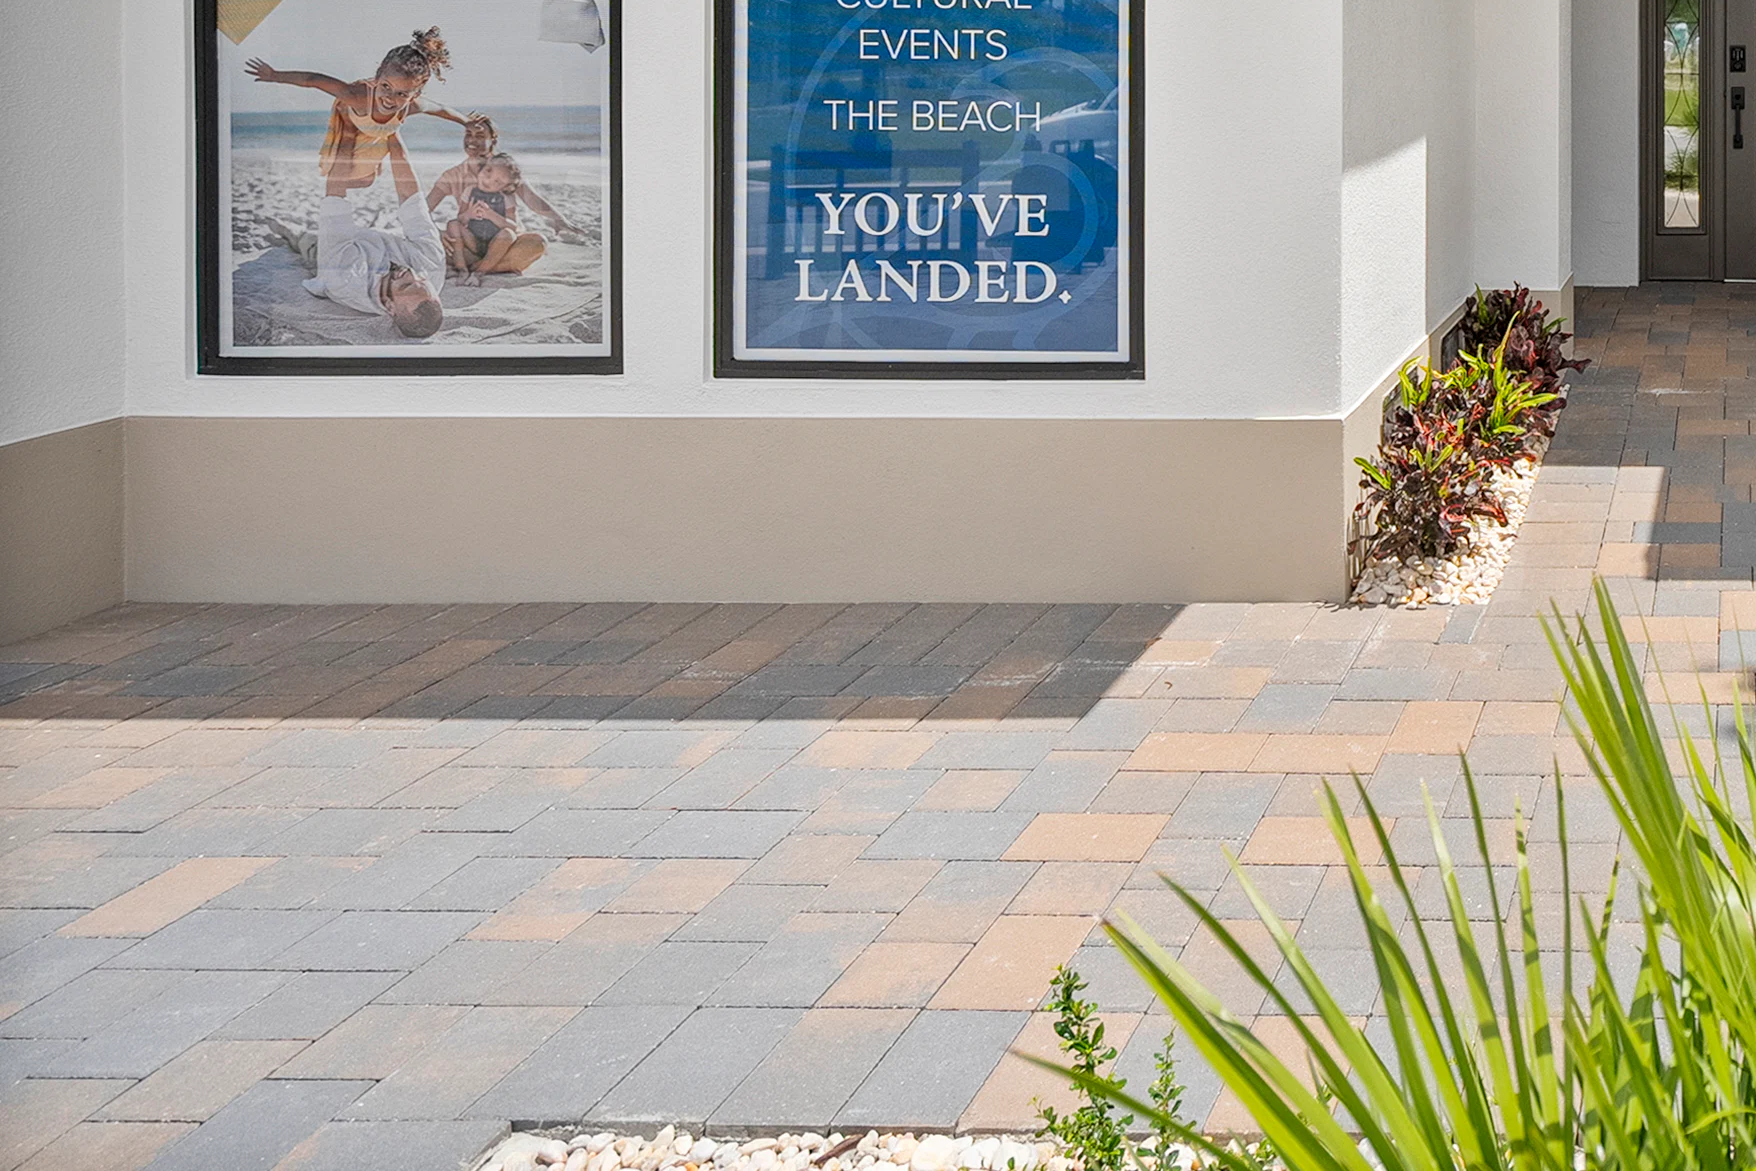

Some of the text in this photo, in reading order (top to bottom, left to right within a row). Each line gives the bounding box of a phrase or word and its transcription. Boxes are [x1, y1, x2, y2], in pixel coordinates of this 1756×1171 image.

[858, 28, 1009, 61] EVENTS
[824, 99, 1042, 133] THE BEACH
[815, 191, 1050, 238] YOU'VE
